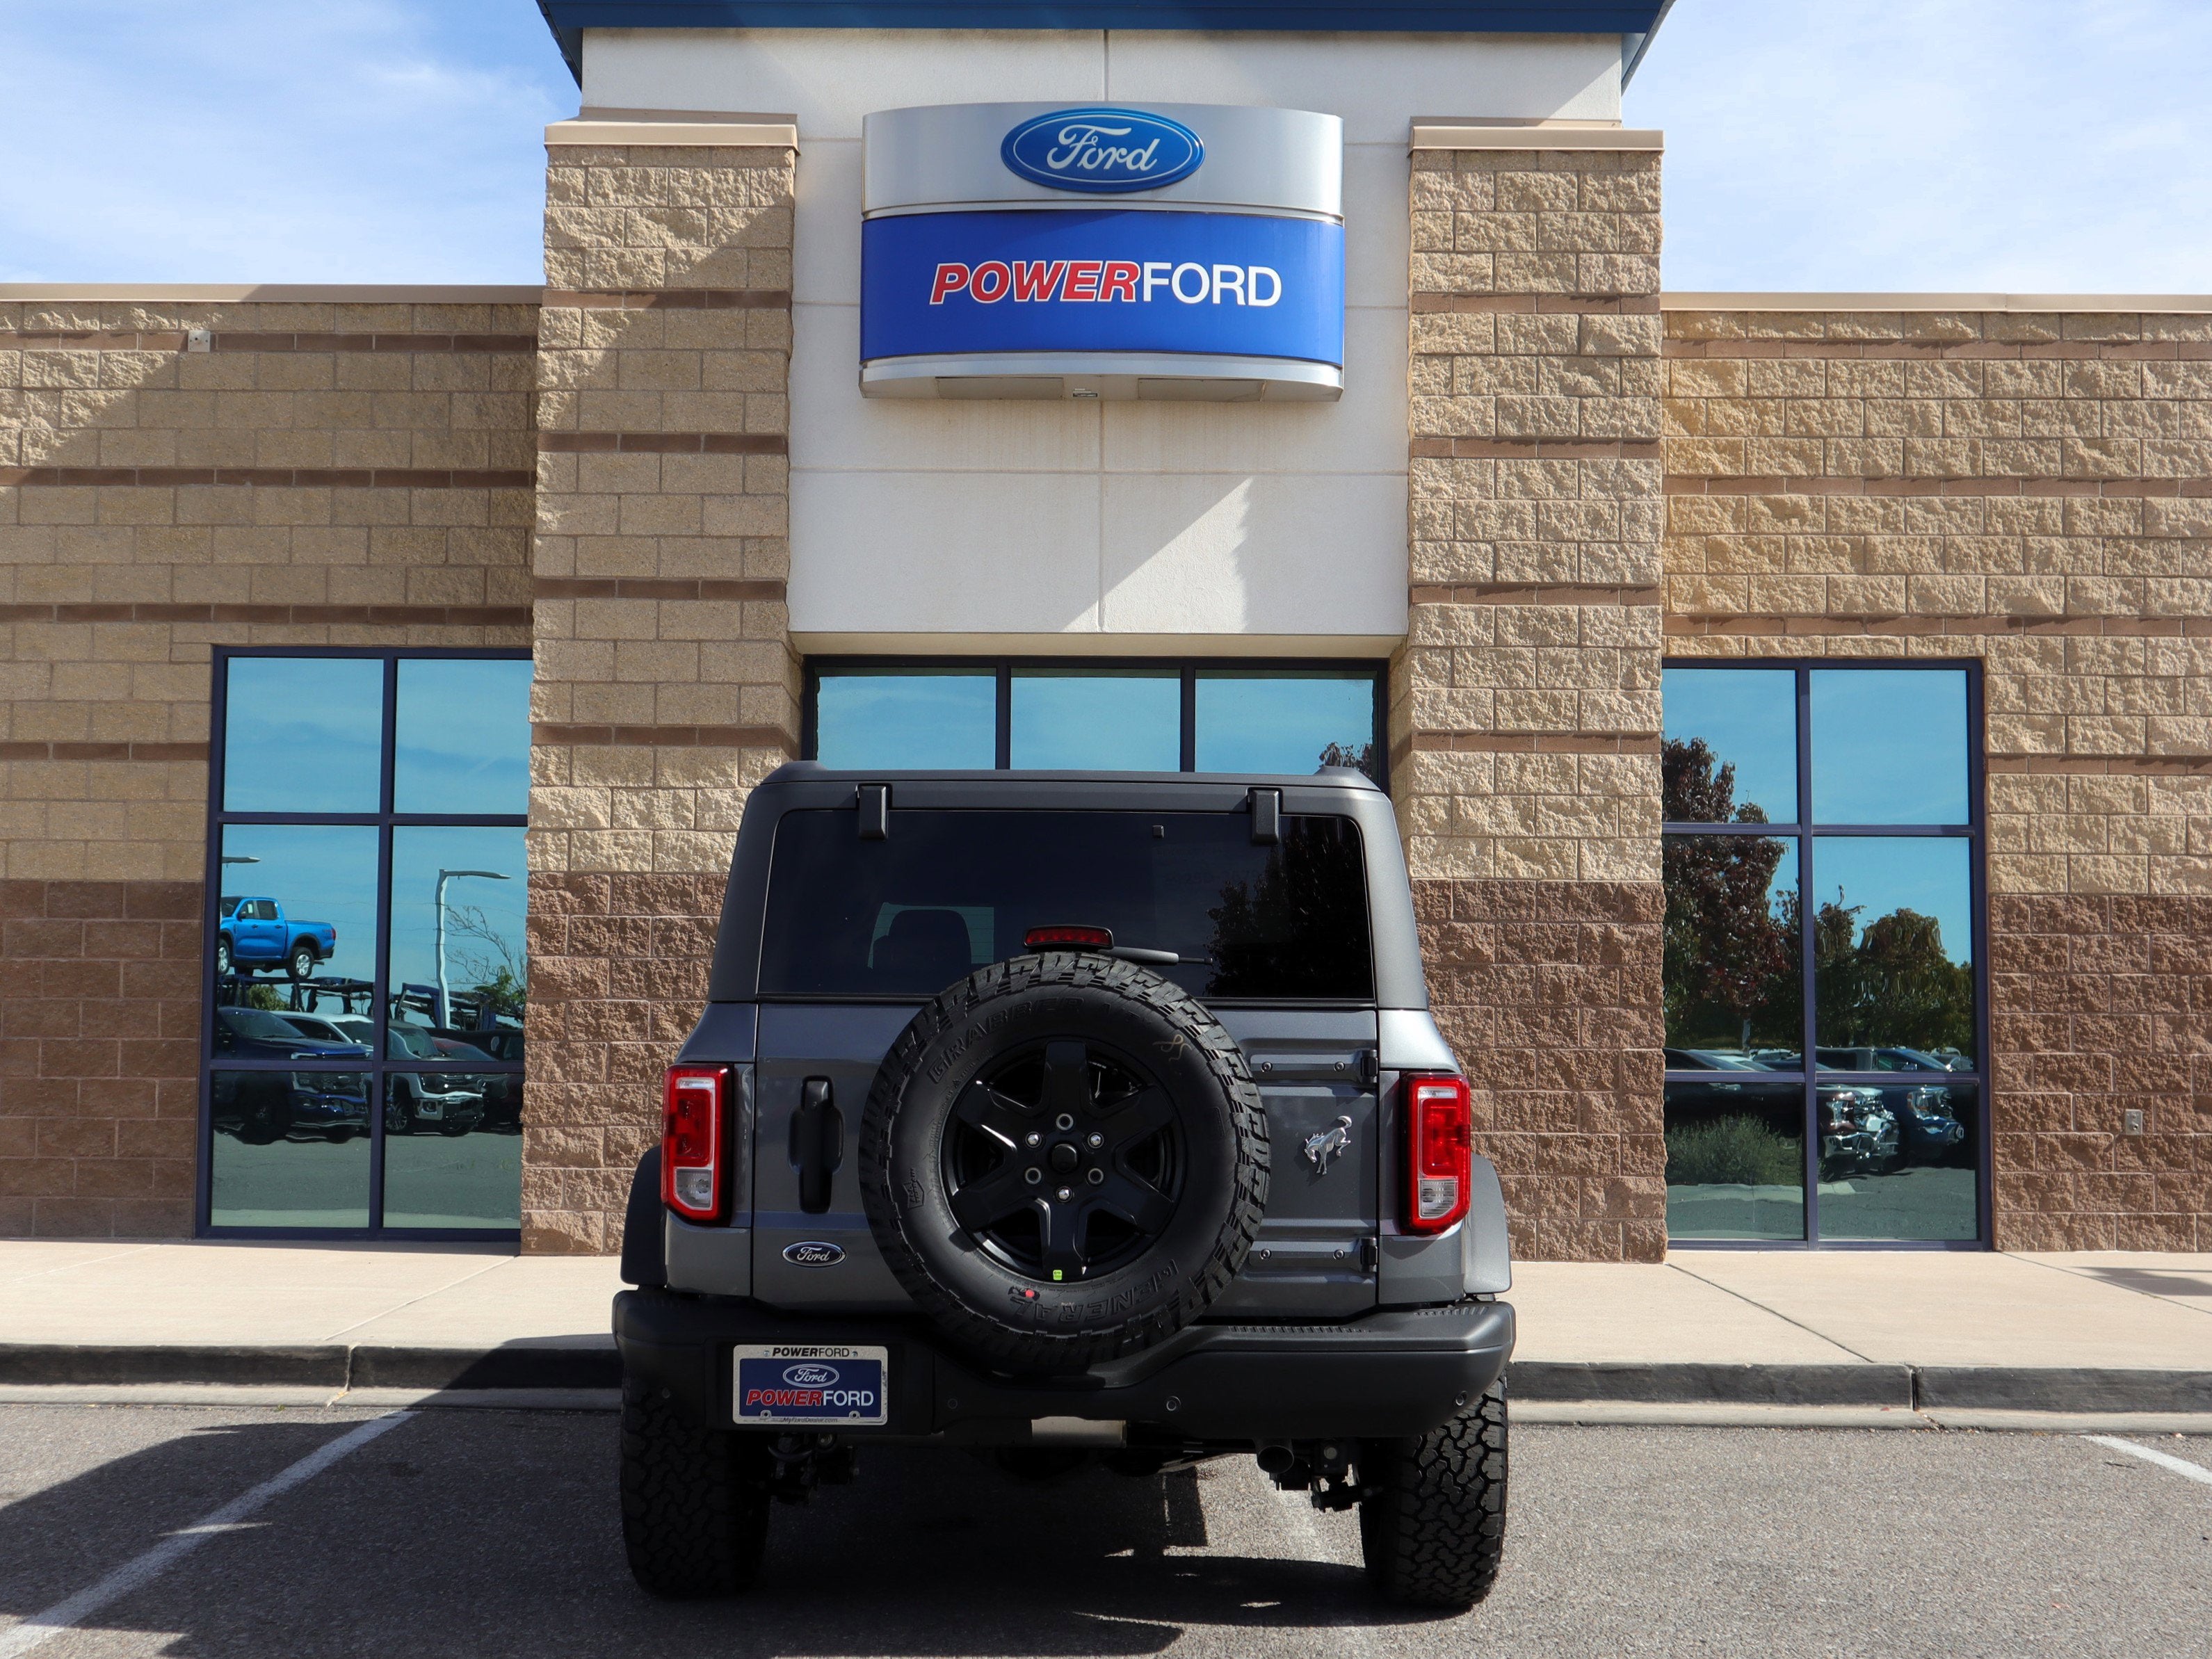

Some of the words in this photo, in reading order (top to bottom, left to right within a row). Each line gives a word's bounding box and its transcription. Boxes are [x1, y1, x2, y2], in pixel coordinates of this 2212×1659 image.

[1047, 124, 1159, 172] Ford
[929, 260, 1282, 307] POWERFORD
[796, 1246, 830, 1262] Ford
[772, 1347, 850, 1358] POWERFORD
[793, 1368, 828, 1383] Ford
[745, 1389, 874, 1407] POWERFORD
